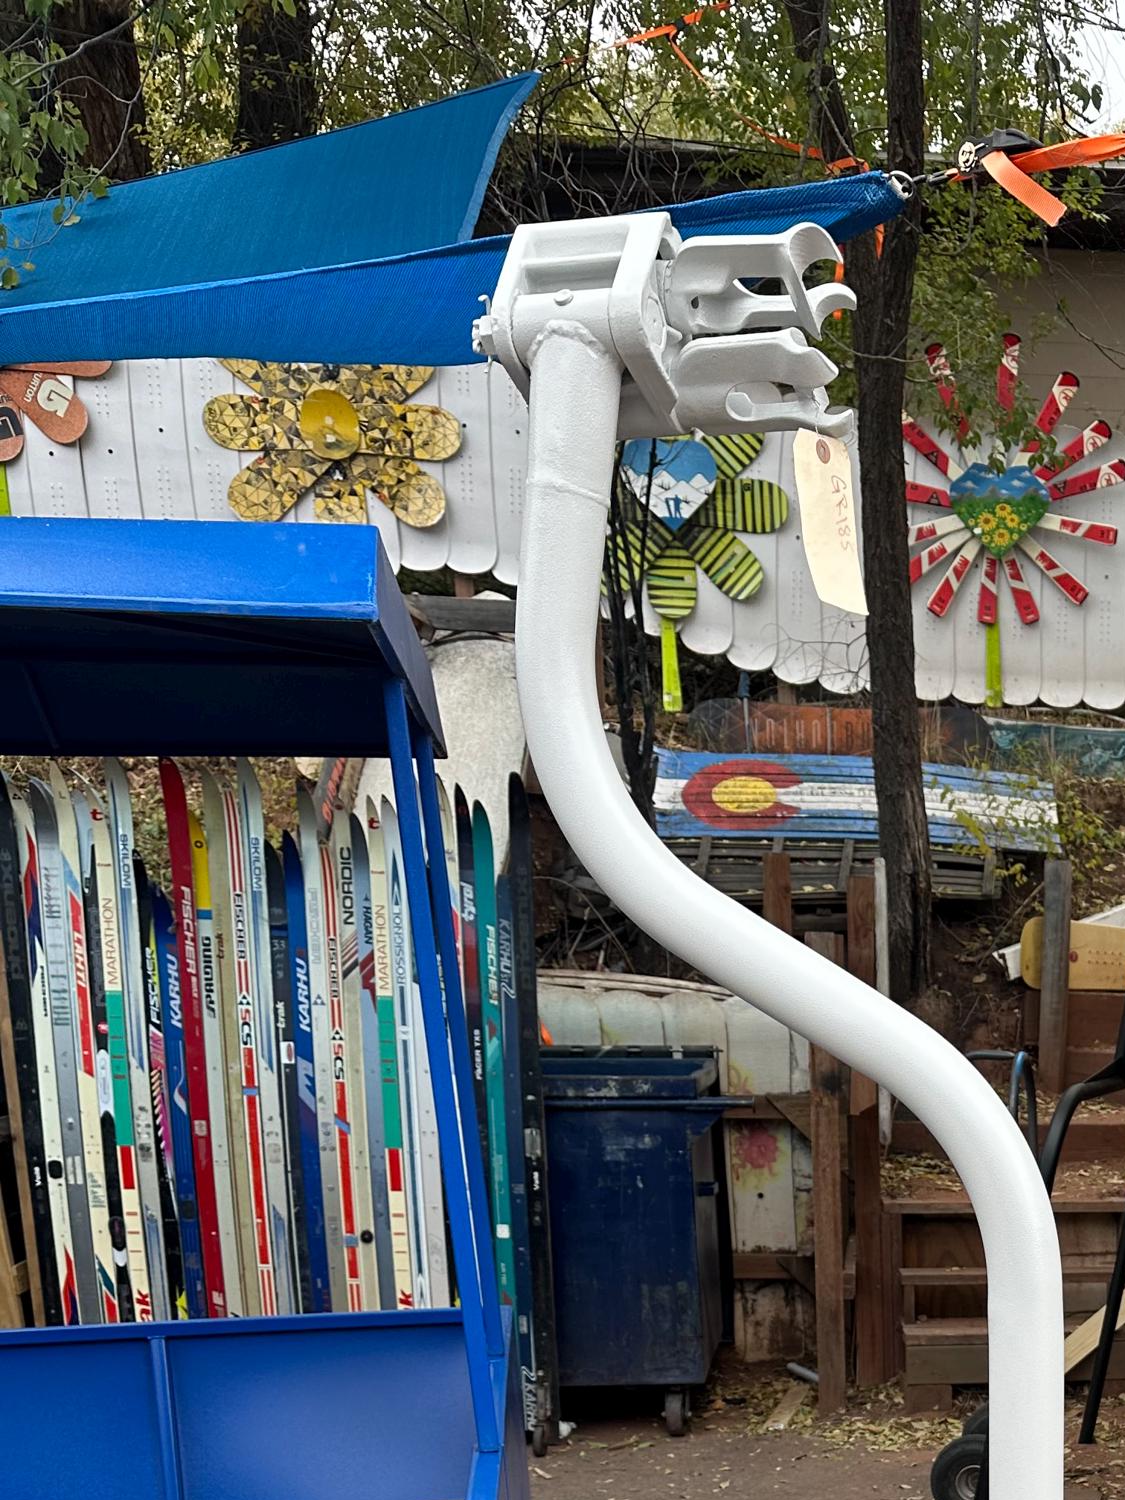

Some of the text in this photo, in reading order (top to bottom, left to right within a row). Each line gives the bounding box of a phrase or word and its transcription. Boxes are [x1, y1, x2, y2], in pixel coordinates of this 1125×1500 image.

[24, 373, 43, 402] URTON
[340, 846, 354, 925] NORDIC
[102, 898, 120, 985] MARATHON
[180, 886, 197, 975] FISCHER
[234, 891, 245, 960] FISCHER
[362, 906, 373, 945] HAGAN
[374, 904, 388, 990] MARATHON
[392, 912, 404, 986] ROSSIGNOL
[498, 918, 512, 973] KARHU
[72, 931, 87, 988] LAHTI
[167, 953, 182, 1029] KARHU
[329, 937, 340, 999] FISCHER
[240, 1007, 253, 1046] SCS
[275, 1001, 286, 1029] trak
[296, 957, 311, 1032] KARHU
[333, 1041, 345, 1080] SCS
